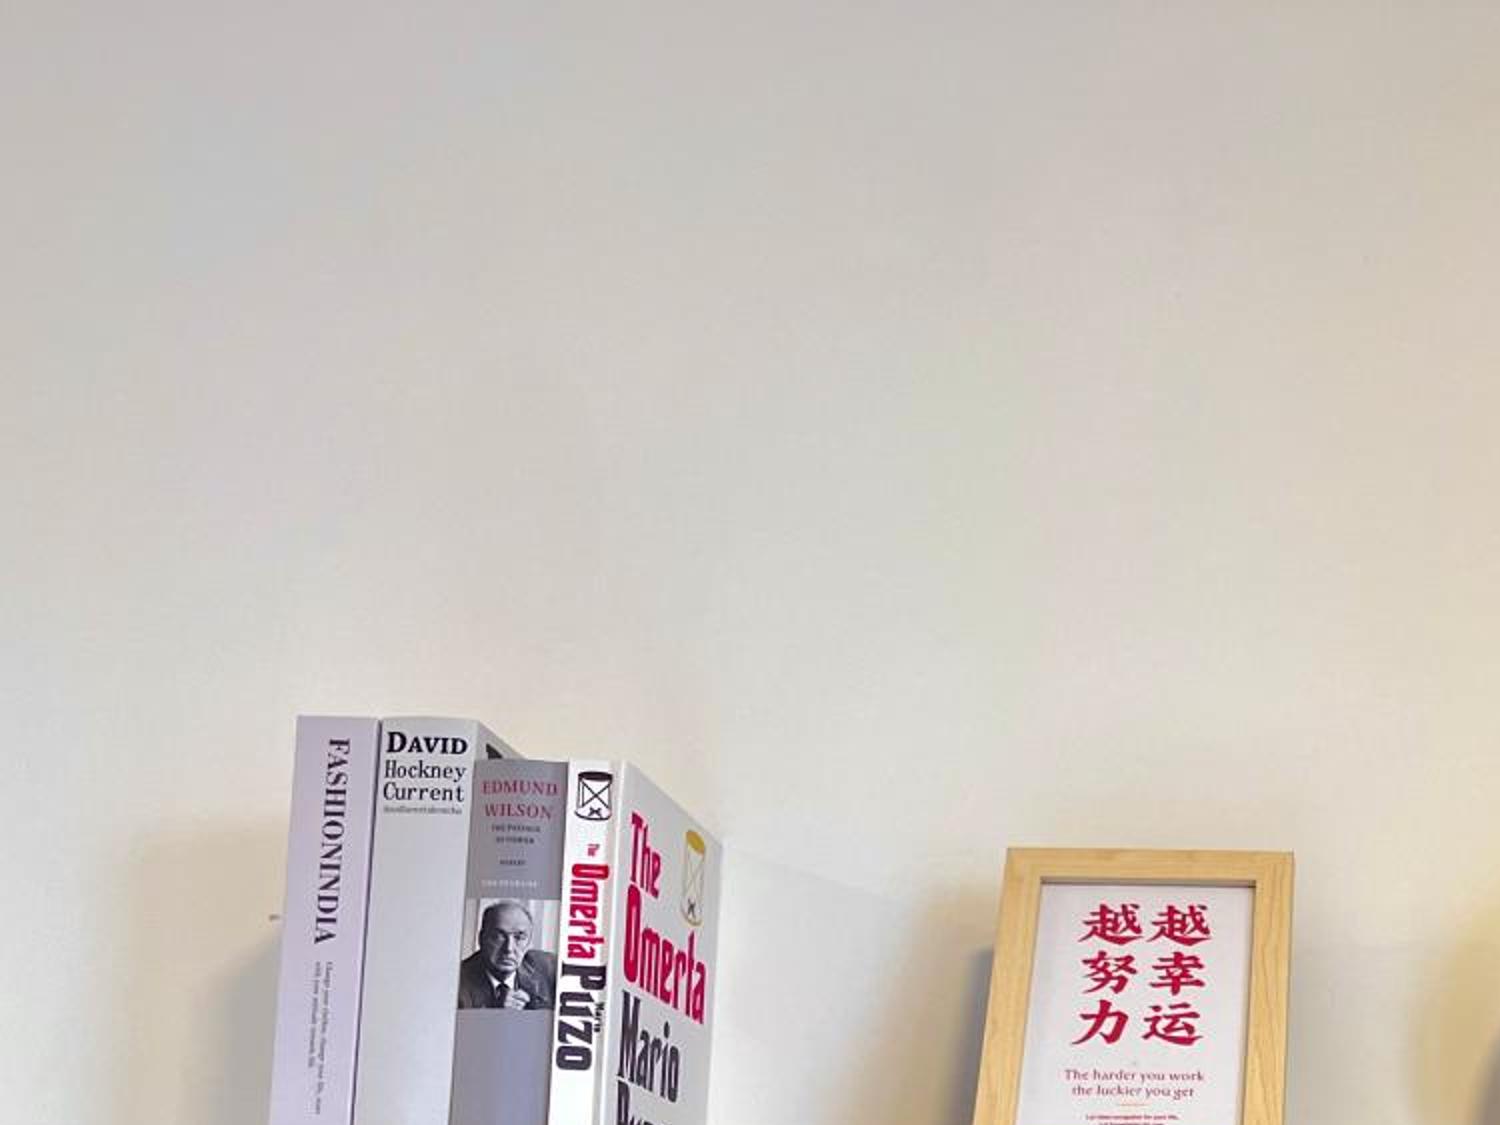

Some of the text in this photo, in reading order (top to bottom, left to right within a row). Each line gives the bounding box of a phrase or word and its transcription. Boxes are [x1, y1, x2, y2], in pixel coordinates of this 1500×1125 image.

[384, 759, 467, 783] Hockney
[387, 731, 469, 755] DAVID
[383, 781, 465, 803] Current
[481, 779, 558, 797] EDMUND
[485, 803, 553, 819] WILSON
[313, 738, 350, 945] FASHIONINDIA
[631, 811, 662, 899] The
[567, 863, 610, 960] Omerta
[623, 883, 706, 1025] Omerta
[556, 963, 607, 1071] Puzo
[1070, 903, 1144, 1045] 越努力
[1141, 903, 1212, 1046] 越幸运
[617, 989, 681, 1103] Mario
[1064, 1068, 1205, 1083] The harder you work
[1072, 1084, 1195, 1101] the luckier you get
